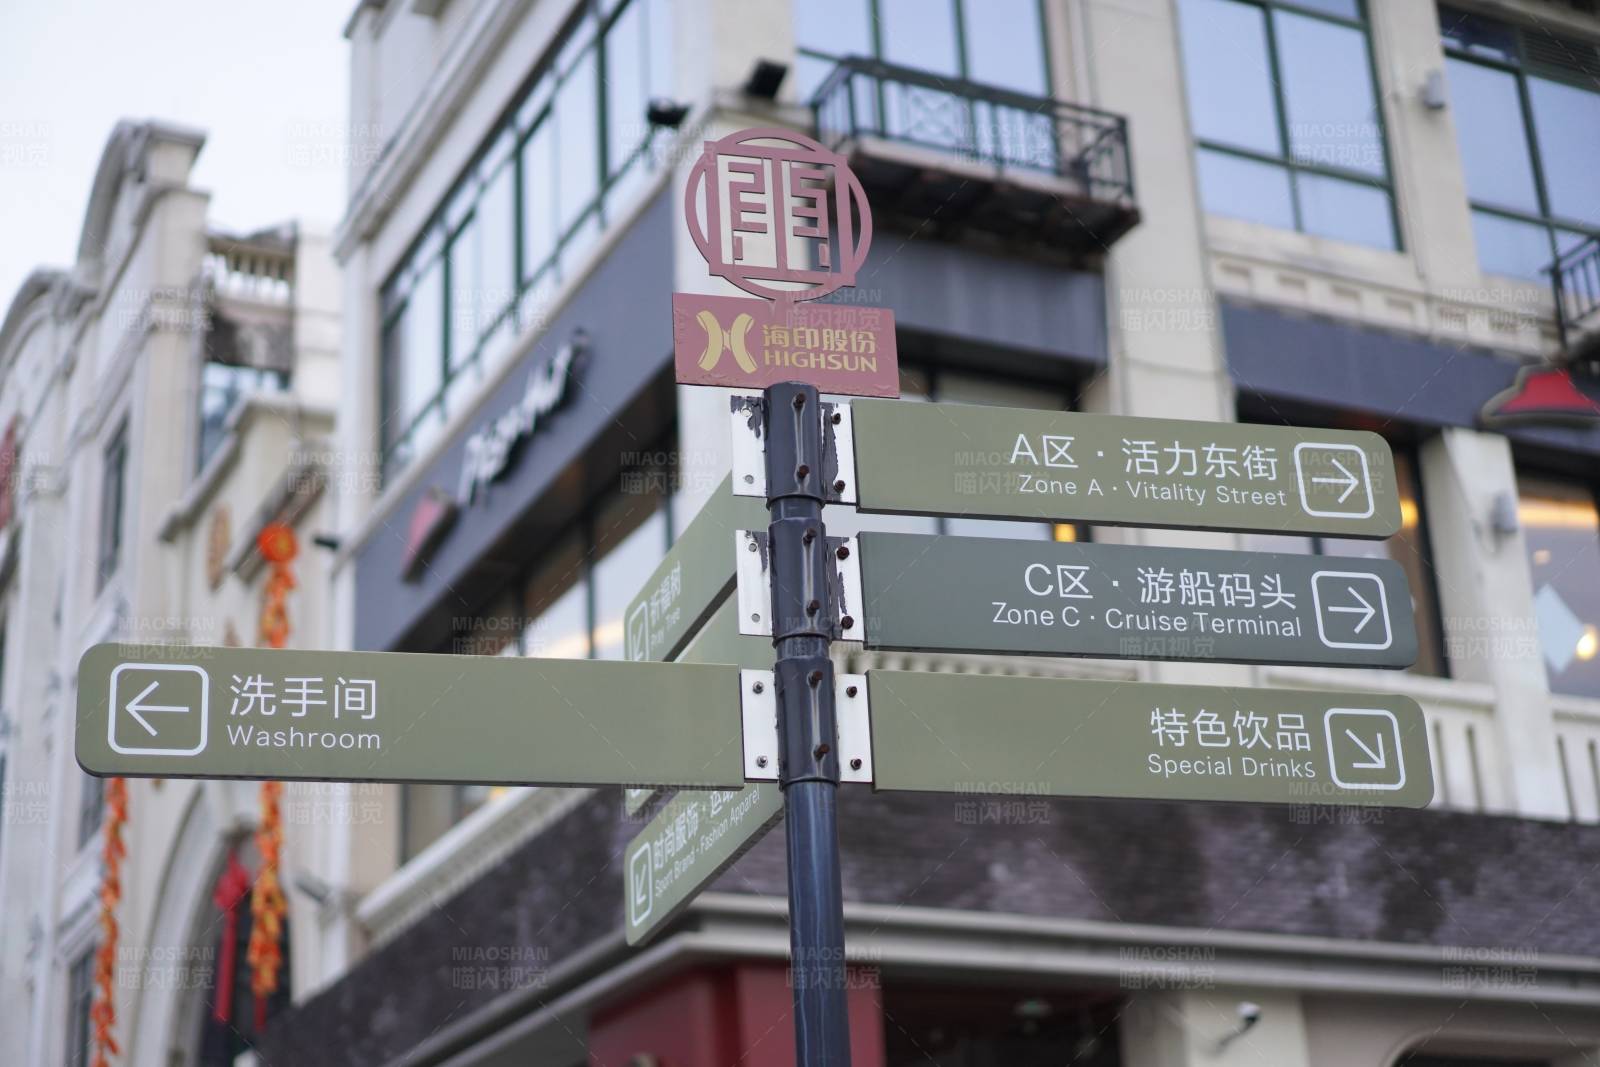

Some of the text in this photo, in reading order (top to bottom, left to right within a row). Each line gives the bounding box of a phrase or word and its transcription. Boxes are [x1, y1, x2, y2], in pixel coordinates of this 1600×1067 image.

[763, 325, 876, 354] 海印股份
[764, 350, 877, 373] HIGHSUN
[1010, 433, 1078, 468] A区
[1121, 437, 1278, 481] 活力东街
[1019, 474, 1077, 496] Zone
[1087, 478, 1103, 497] A
[1126, 480, 1206, 506] Vitality
[1216, 485, 1287, 506] Street
[1024, 563, 1093, 599] C区
[1137, 567, 1296, 609] 游船码头
[991, 601, 1054, 626] Zone
[1062, 606, 1081, 627] C
[1105, 608, 1187, 632] Cruise
[1192, 611, 1301, 637] Terminal
[230, 674, 376, 719] 洗手间
[227, 724, 380, 749] Washroom
[1150, 707, 1312, 751] 特色饮品
[1148, 753, 1316, 778] Special Drinks
[700, 820, 728, 855] Fashion
[730, 784, 760, 826] Apparel
